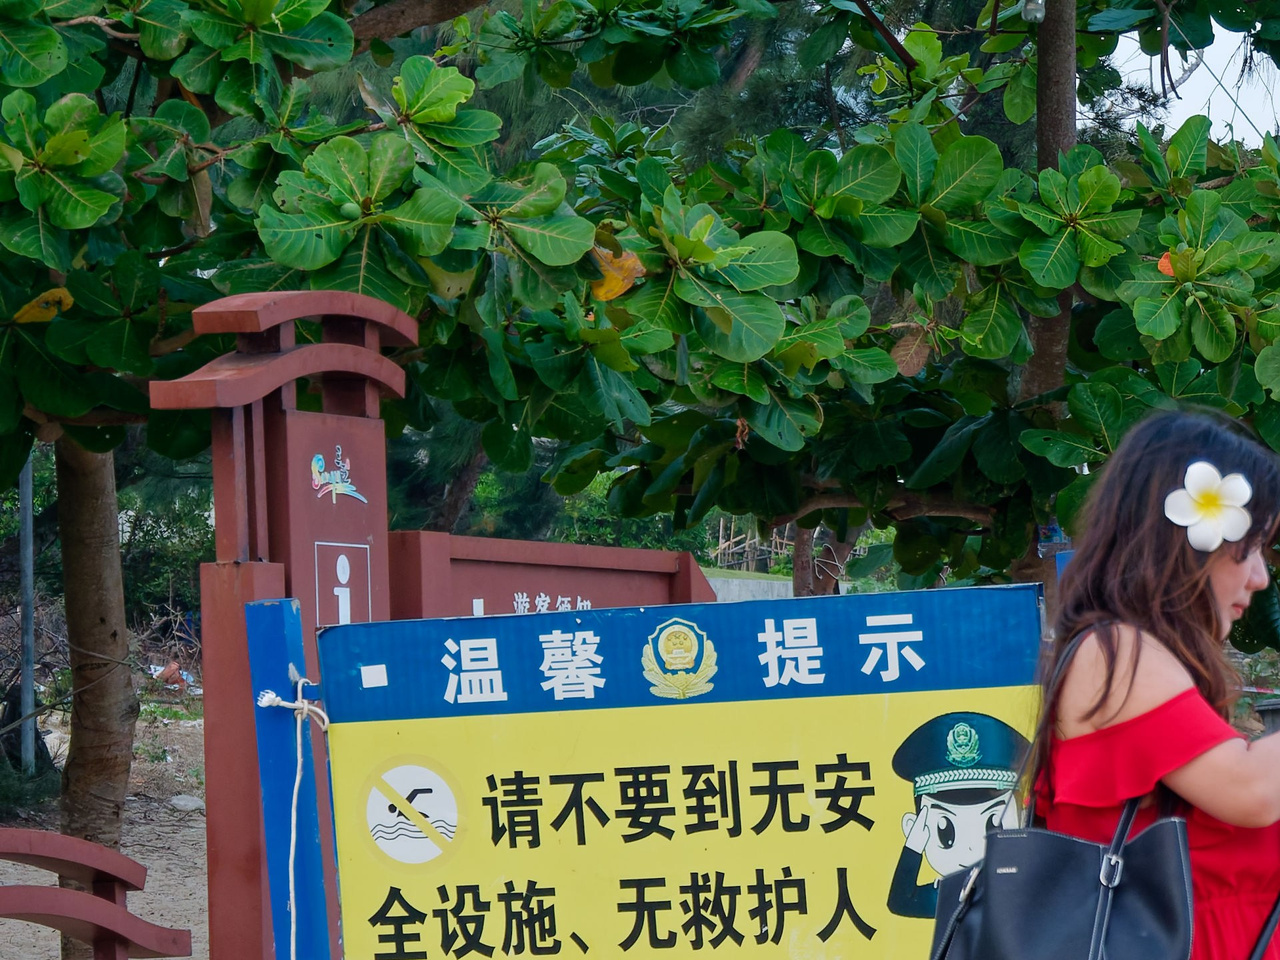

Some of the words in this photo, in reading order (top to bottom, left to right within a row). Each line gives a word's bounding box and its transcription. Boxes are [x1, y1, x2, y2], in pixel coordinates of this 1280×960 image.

[440, 629, 607, 705] 温馨
[758, 613, 927, 688] 提示
[482, 752, 877, 850] 请不要到无安
